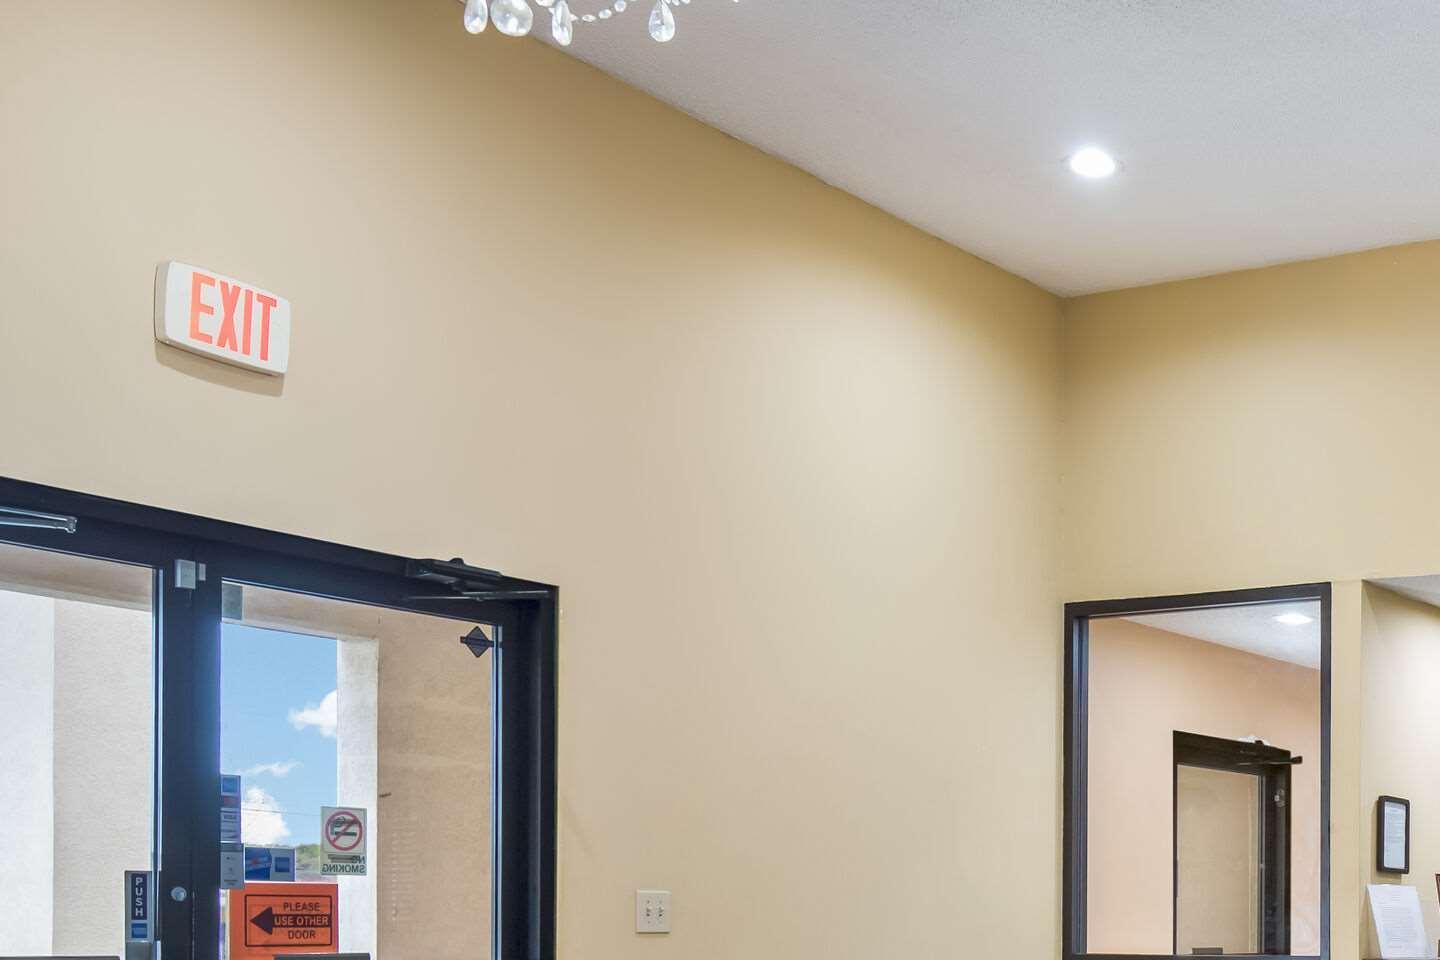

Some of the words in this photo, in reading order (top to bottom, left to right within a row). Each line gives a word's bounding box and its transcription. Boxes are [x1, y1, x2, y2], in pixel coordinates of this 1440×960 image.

[189, 271, 277, 361] EXIT
[135, 877, 144, 917] PUSH
[283, 902, 321, 912] PLEASE
[274, 915, 294, 926] USE
[296, 915, 329, 926] OTHER
[288, 930, 316, 940] DOOR
